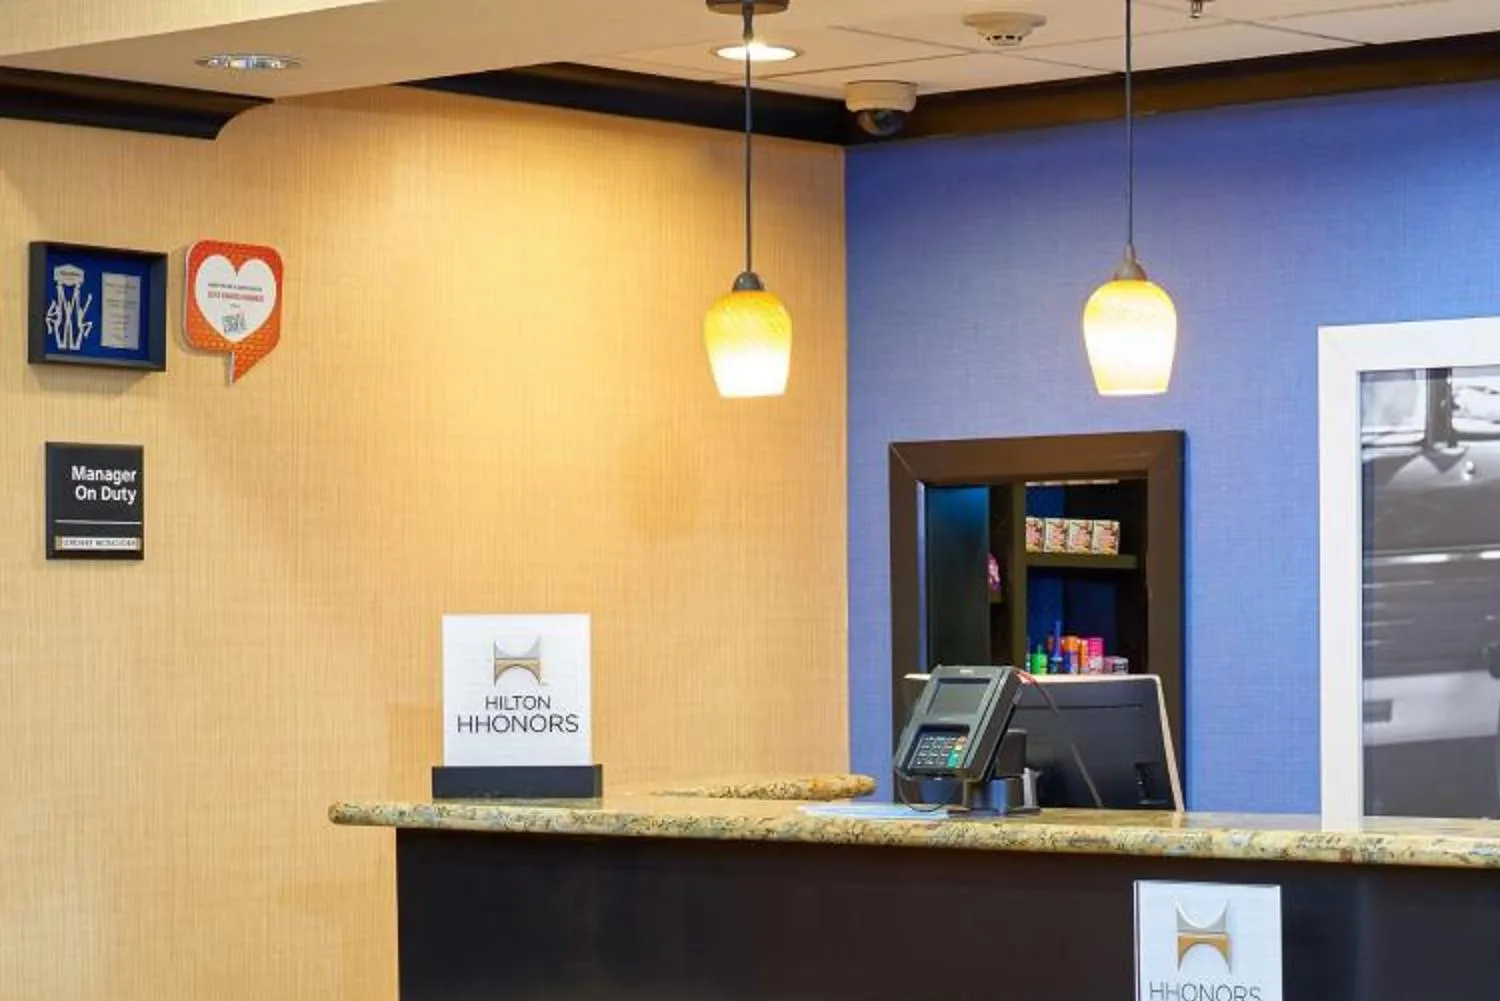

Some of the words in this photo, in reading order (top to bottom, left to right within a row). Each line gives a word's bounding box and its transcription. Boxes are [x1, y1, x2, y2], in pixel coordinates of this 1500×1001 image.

[71, 465, 137, 485] Manager
[75, 485, 97, 501] On
[101, 485, 137, 505] Duty
[485, 695, 551, 711] HILTON
[457, 713, 580, 734] HHONORS
